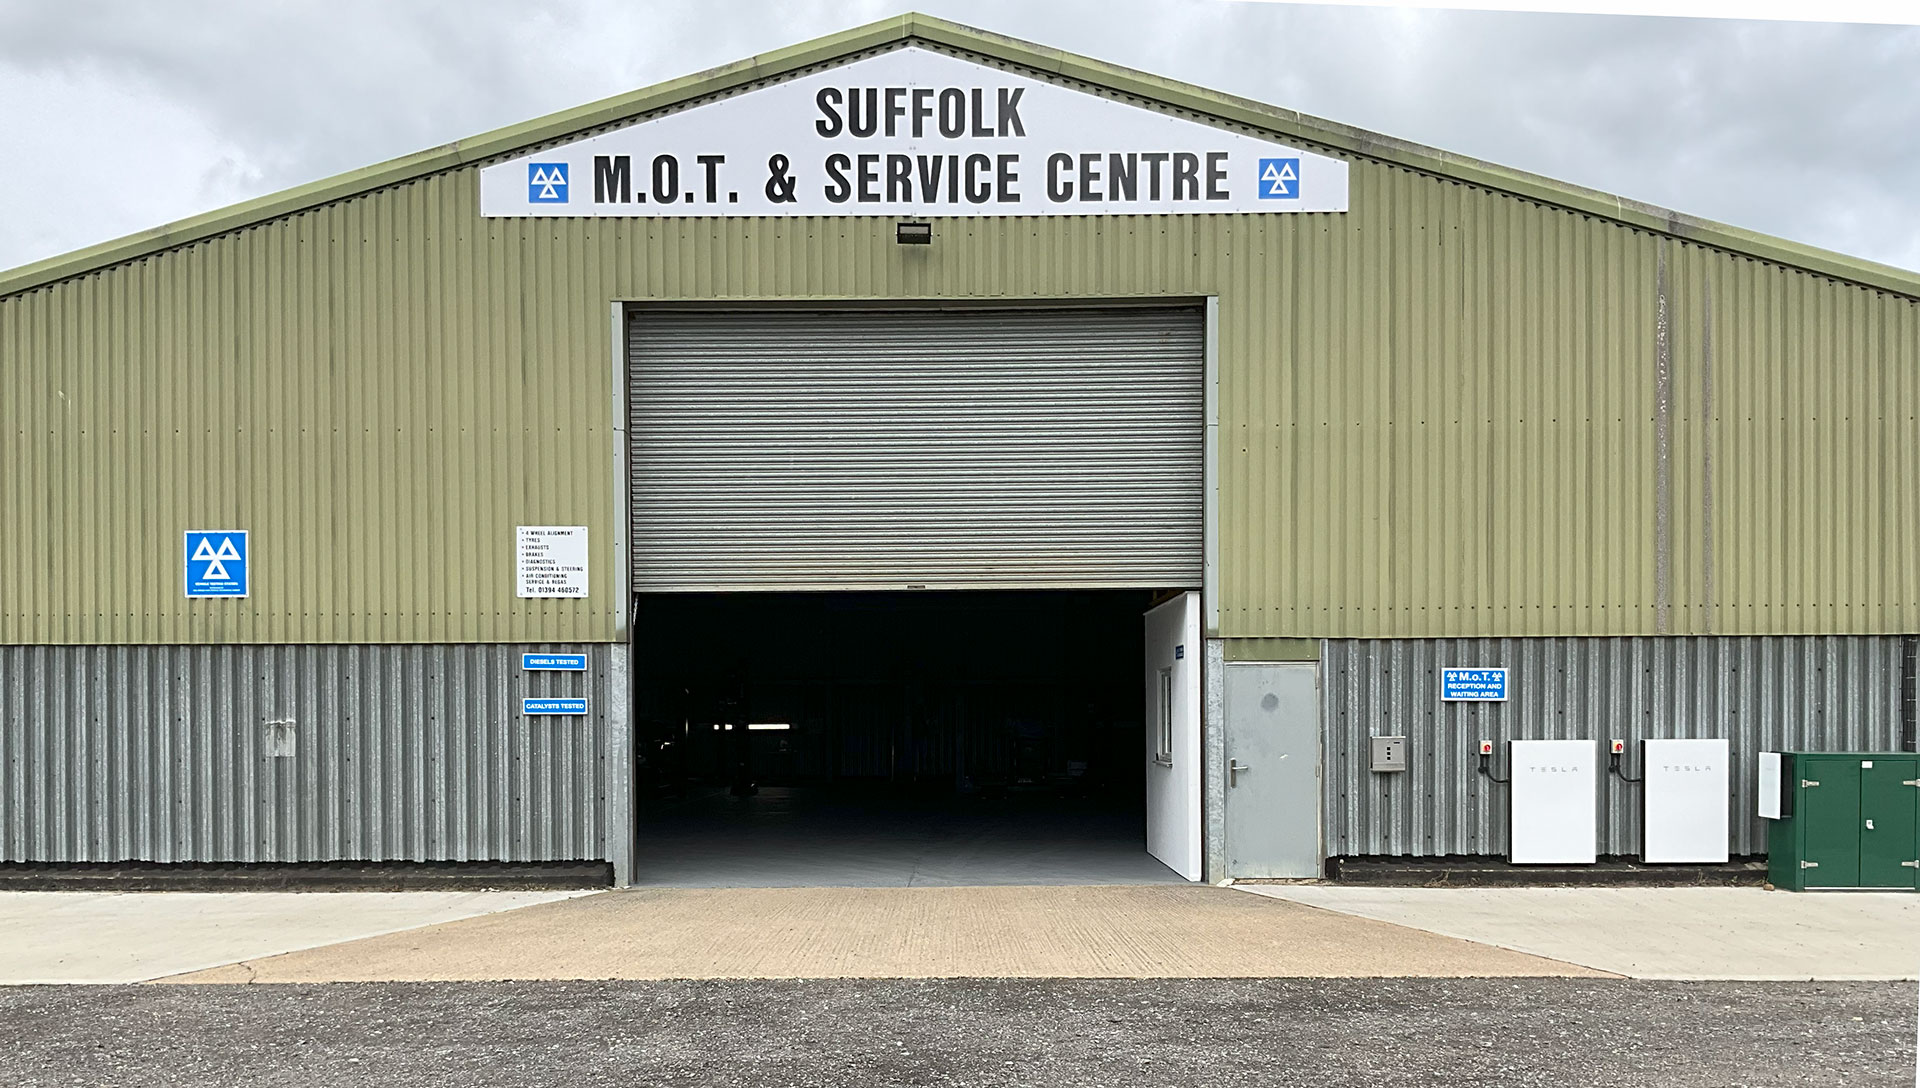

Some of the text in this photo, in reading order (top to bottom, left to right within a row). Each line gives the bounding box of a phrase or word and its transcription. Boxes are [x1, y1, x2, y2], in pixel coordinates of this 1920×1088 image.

[816, 88, 1025, 138] SUFFOLK
[595, 152, 1229, 203] M.O.T. & SERVICE CENTRE
